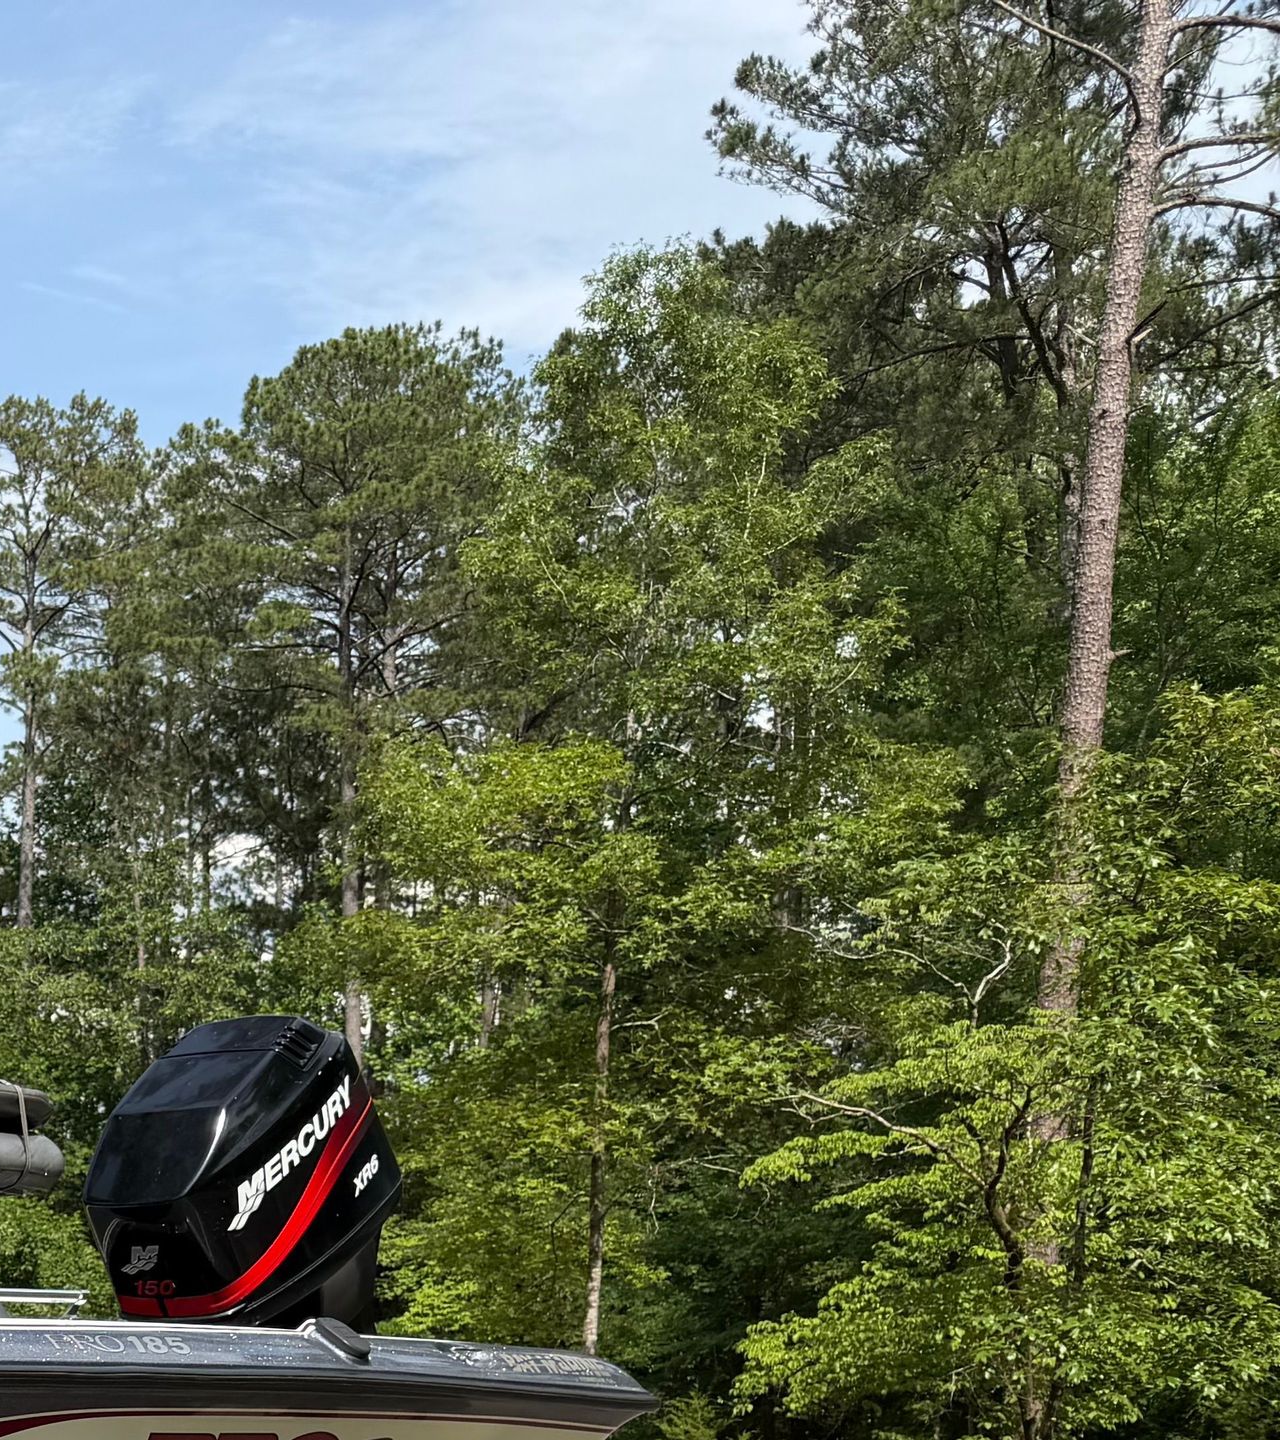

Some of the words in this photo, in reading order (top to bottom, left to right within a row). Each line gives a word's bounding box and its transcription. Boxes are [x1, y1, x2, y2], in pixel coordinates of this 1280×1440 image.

[227, 1074, 351, 1231] MERCURY
[352, 1153, 379, 1198] XR6
[133, 1279, 176, 1295] 150
